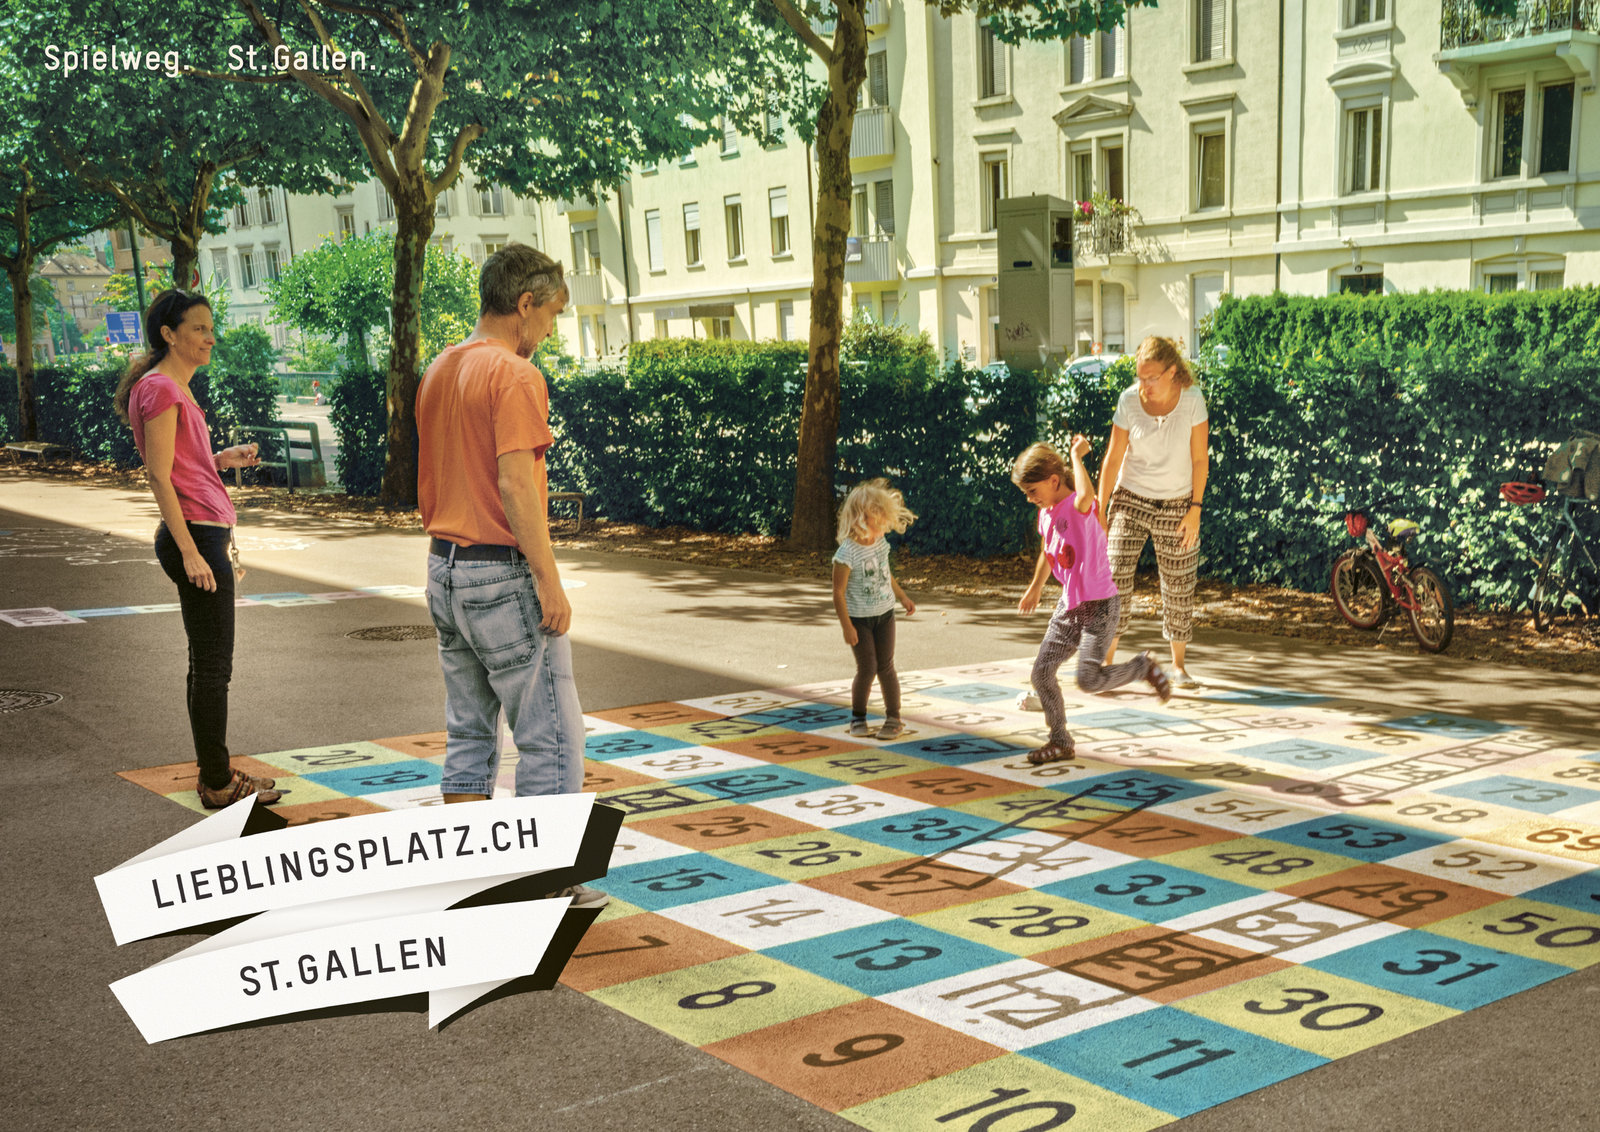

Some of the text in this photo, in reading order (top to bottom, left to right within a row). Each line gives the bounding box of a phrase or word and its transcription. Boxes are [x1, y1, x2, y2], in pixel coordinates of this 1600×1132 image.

[712, 696, 782, 709] 60
[629, 709, 692, 723] 41
[933, 711, 1005, 726] 63
[290, 748, 374, 768] 20
[753, 740, 830, 756] 43
[1093, 743, 1172, 758] 65
[1266, 743, 1345, 761] 75
[642, 754, 724, 772] 38
[826, 757, 907, 776] 44
[1185, 761, 1266, 779] 66
[351, 770, 429, 787] 19
[906, 776, 994, 796] 45
[1099, 777, 1184, 800] 55
[1479, 782, 1569, 803] 73
[794, 794, 886, 816] 36
[1193, 799, 1292, 823] 54
[1397, 802, 1489, 823] 68
[672, 816, 771, 838] 25
[881, 817, 979, 842] 35
[1103, 826, 1199, 843] 47
[1307, 824, 1407, 849] 53
[755, 840, 863, 867] 26
[1211, 851, 1315, 876] 48
[1432, 850, 1538, 880] 52
[630, 868, 728, 892] 15
[1093, 873, 1206, 907] 33
[1344, 881, 1448, 909] 49
[719, 898, 825, 929] 14
[968, 905, 1090, 938] 28
[1482, 911, 1600, 948] 50
[571, 934, 670, 959] 7
[832, 938, 943, 971] 13
[1382, 949, 1500, 986] 31
[677, 980, 776, 1010] 8
[1243, 987, 1385, 1031] 30
[802, 1033, 905, 1068] 9
[1121, 1037, 1237, 1081] 11
[934, 1087, 1077, 1132] 10
